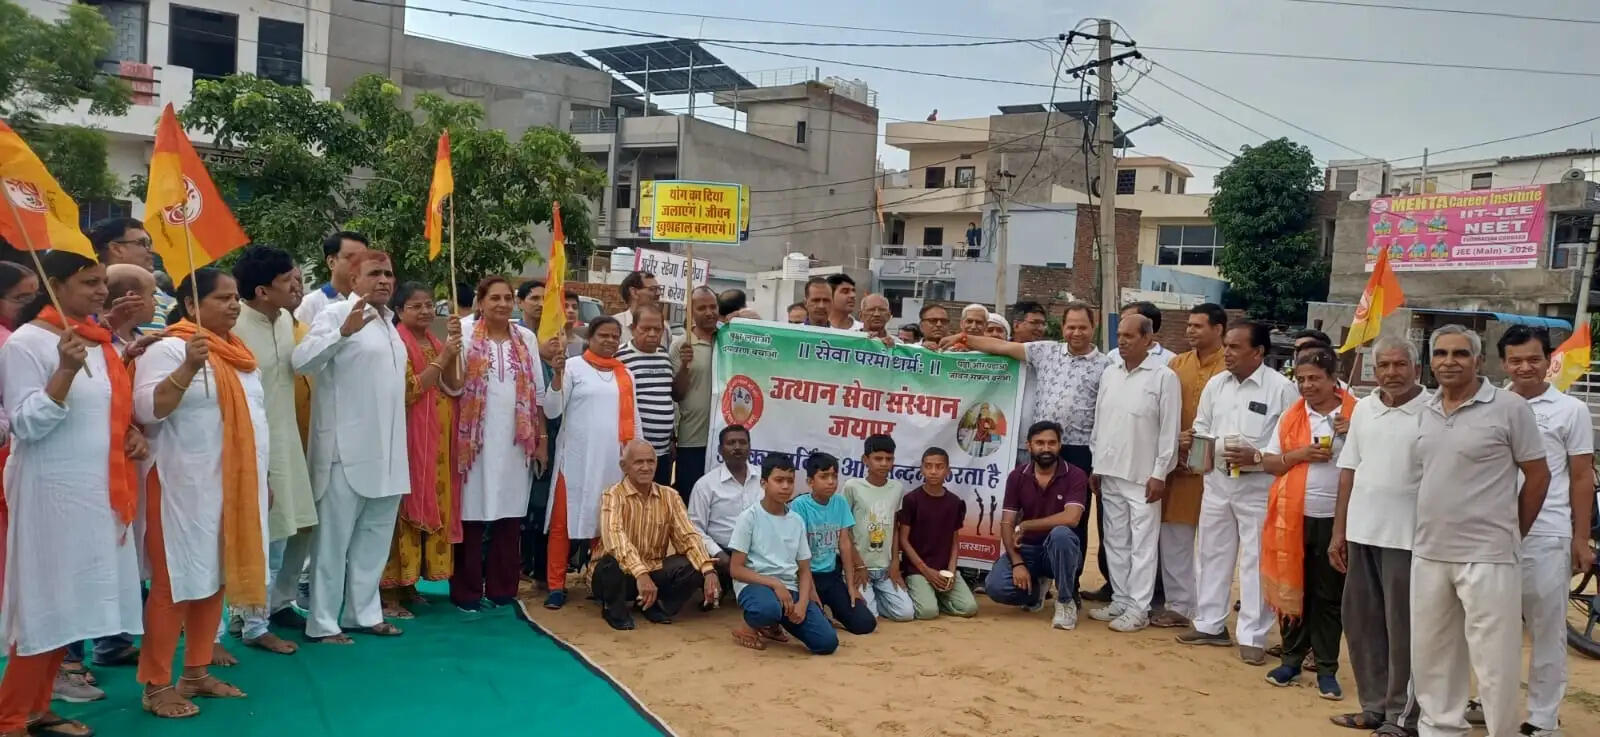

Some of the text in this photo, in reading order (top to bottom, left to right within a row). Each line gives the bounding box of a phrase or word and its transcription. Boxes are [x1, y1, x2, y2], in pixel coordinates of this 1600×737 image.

[704, 188, 723, 202] दिया
[1391, 195, 1448, 212] MEHTA
[1449, 195, 1488, 208] Career
[1490, 190, 1542, 205] Institute
[705, 206, 730, 219] जीवन
[1460, 205, 1534, 219] IIT-JEE
[1464, 219, 1526, 234] NEET
[1456, 248, 1471, 256] JEE
[1473, 246, 1502, 256] (Main)
[1509, 245, 1534, 254] 2026
[815, 340, 850, 363] सेवा
[769, 376, 839, 406] उत्थान
[841, 379, 884, 411] सेवा
[886, 386, 961, 419] संस्थान
[986, 463, 1002, 489] है
